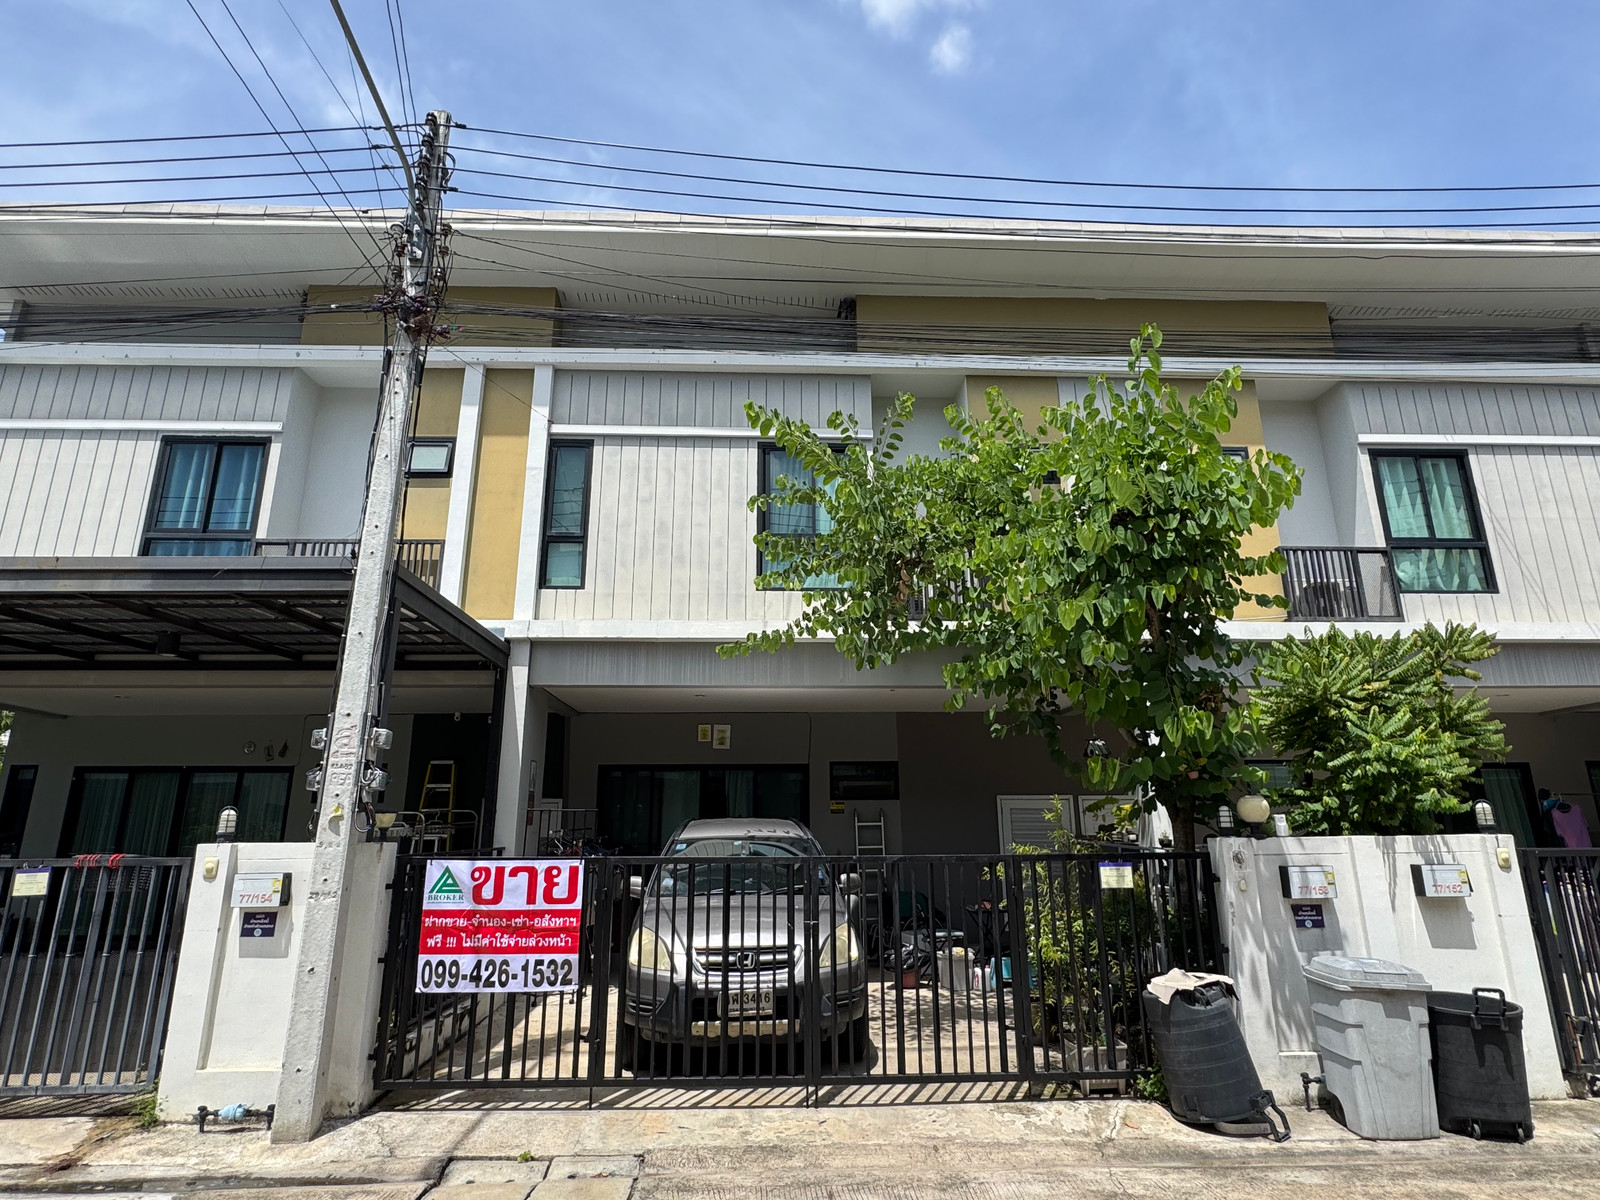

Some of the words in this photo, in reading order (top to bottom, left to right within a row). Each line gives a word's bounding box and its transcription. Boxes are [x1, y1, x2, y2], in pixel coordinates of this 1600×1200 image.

[470, 865, 579, 905] ขาย
[1298, 885, 1329, 895] 77/153
[1432, 884, 1463, 893] 77/152
[239, 893, 273, 904] 77/154
[427, 893, 464, 902] BROKER
[426, 933, 442, 947] ฟรี
[446, 936, 457, 947] !!!
[460, 931, 572, 947] ไม่มีค่าใช้จ่ายล่วงหน้า
[421, 959, 573, 989] 099-426-1532
